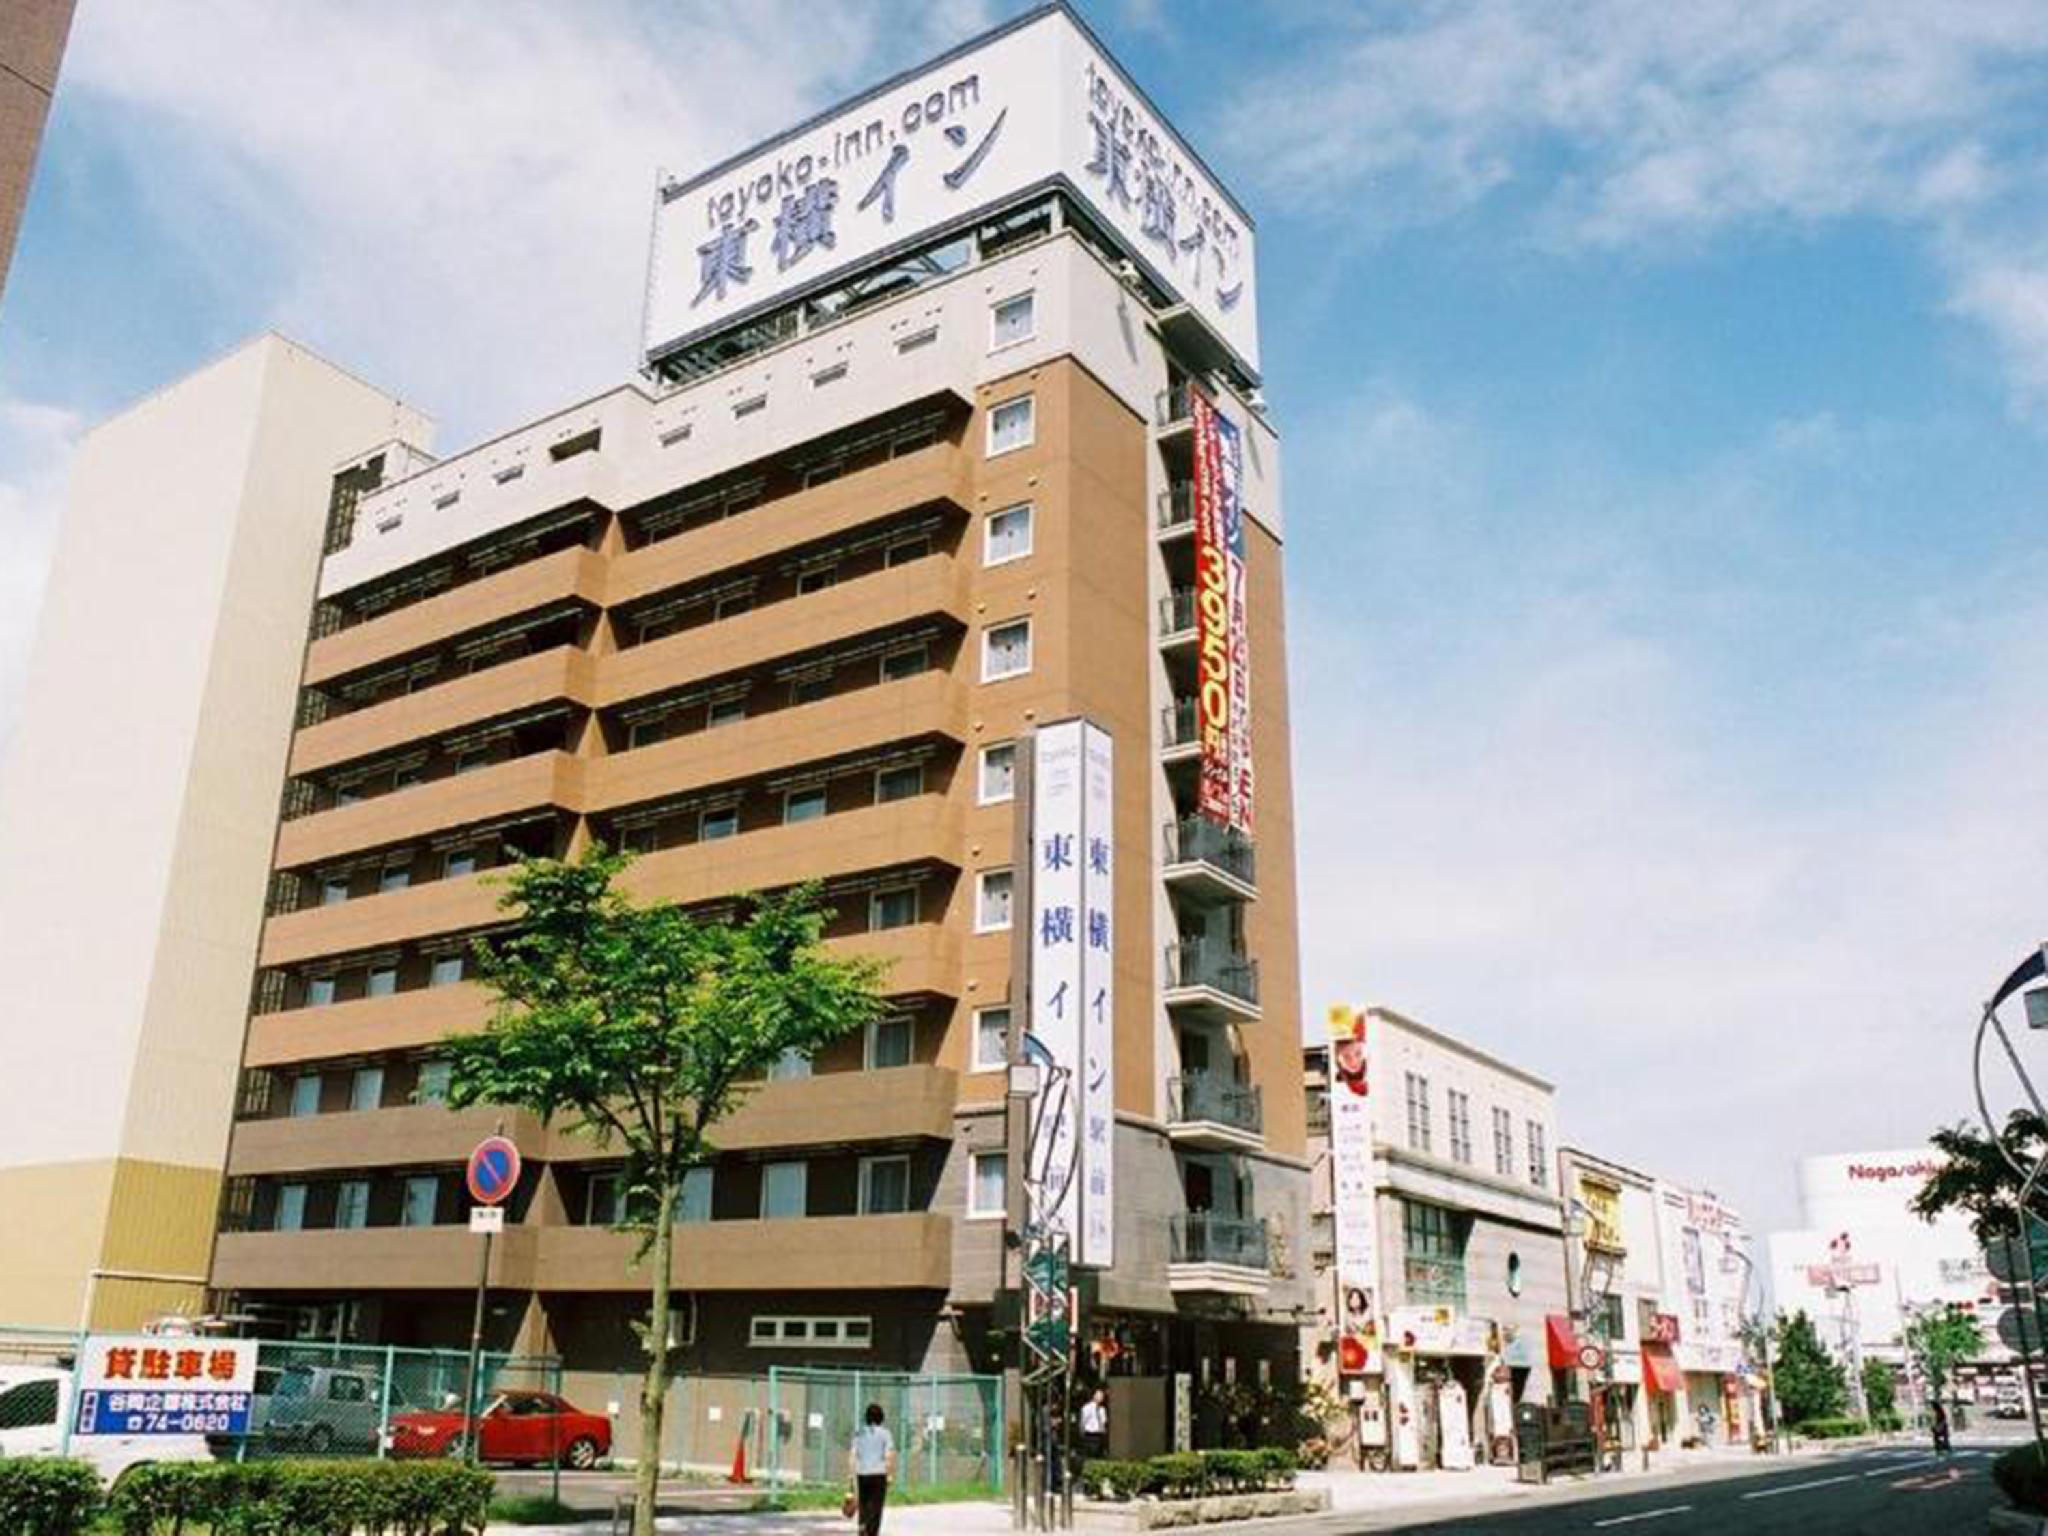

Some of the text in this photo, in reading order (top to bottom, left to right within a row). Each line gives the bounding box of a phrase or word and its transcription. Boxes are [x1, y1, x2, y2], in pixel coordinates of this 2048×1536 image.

[691, 106, 1008, 307] 東横イン
[707, 74, 980, 228] toyoko-inn.com
[105, 1347, 236, 1379] 貸駐車場
